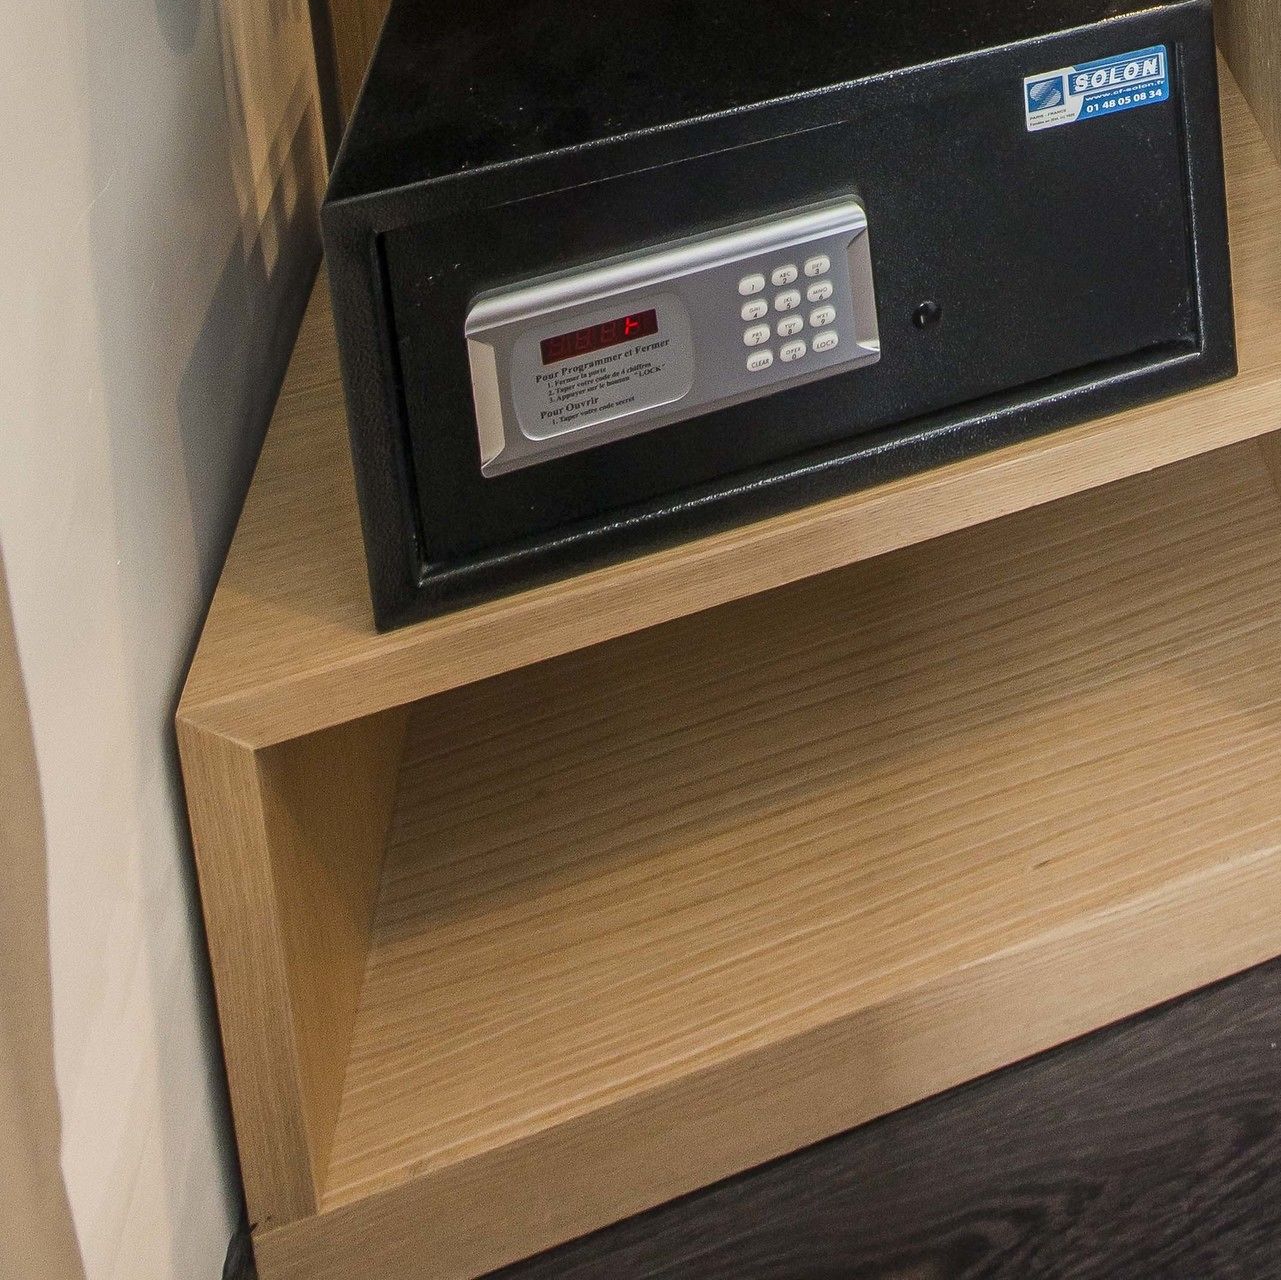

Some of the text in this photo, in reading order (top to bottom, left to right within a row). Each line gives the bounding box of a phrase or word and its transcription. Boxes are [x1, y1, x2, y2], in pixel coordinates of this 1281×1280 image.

[1075, 57, 1158, 91] SOLON
[1086, 89, 1163, 113] 01 48 05 08 34
[816, 340, 834, 349] LOCK
[535, 340, 670, 383] Pour Programmer et Fermer
[751, 358, 769, 368] CLEAR
[539, 395, 599, 419] Pour Ouvrir
